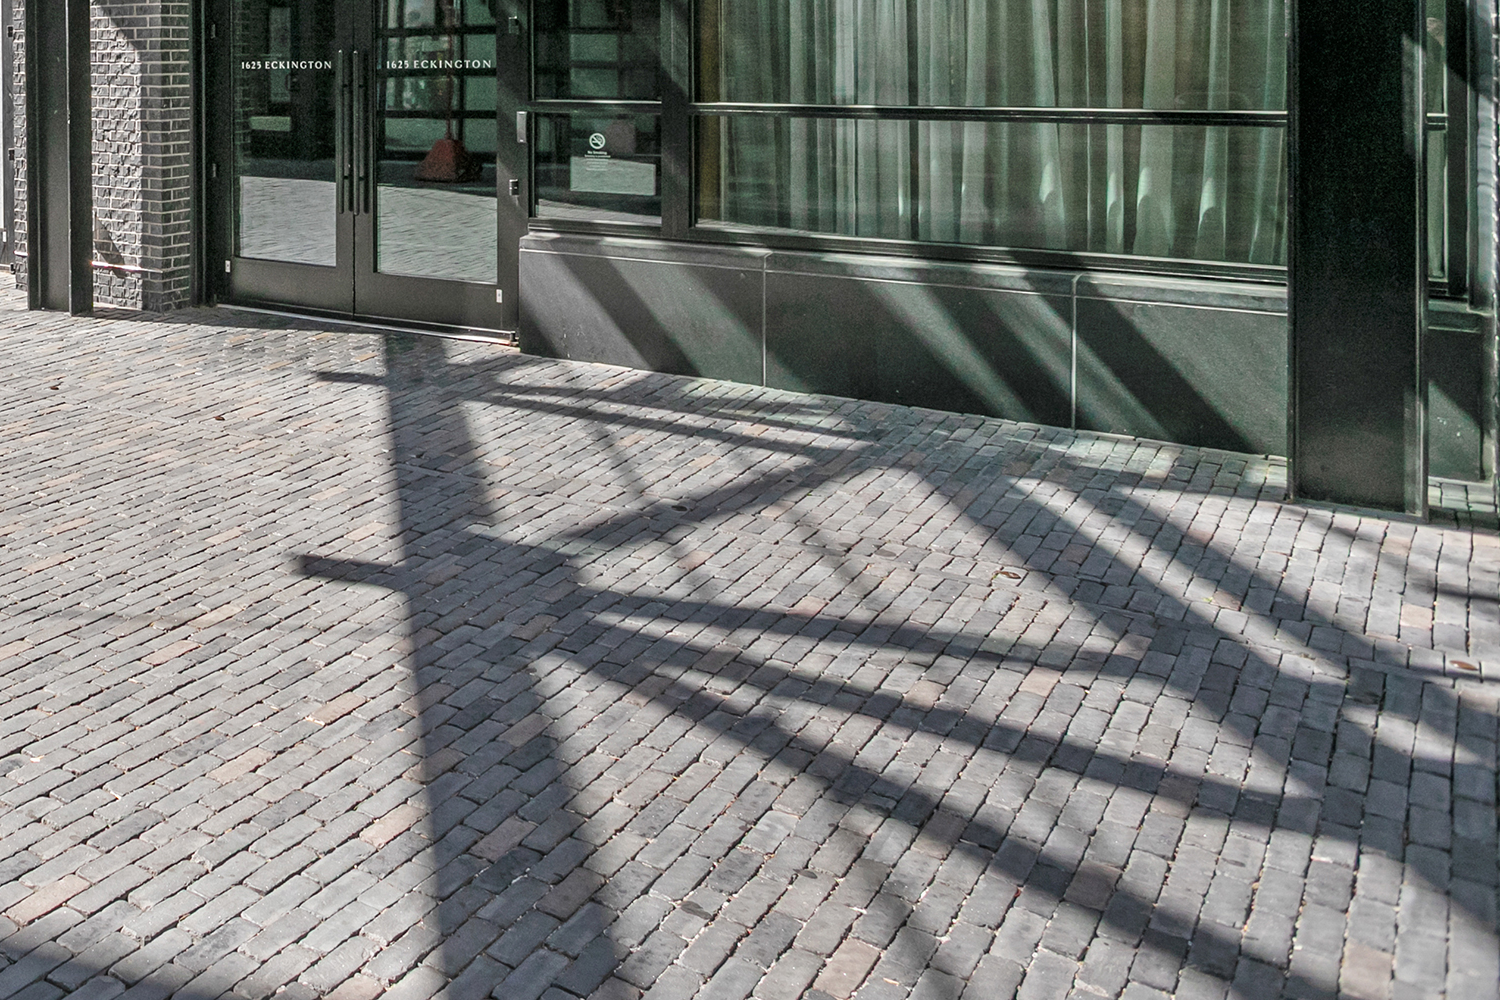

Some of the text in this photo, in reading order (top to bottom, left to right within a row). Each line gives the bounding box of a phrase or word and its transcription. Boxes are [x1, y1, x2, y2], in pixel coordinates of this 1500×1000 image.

[241, 60, 333, 70] 1625 ECKINGTON
[386, 60, 492, 69] 1625 ECKINGTON
